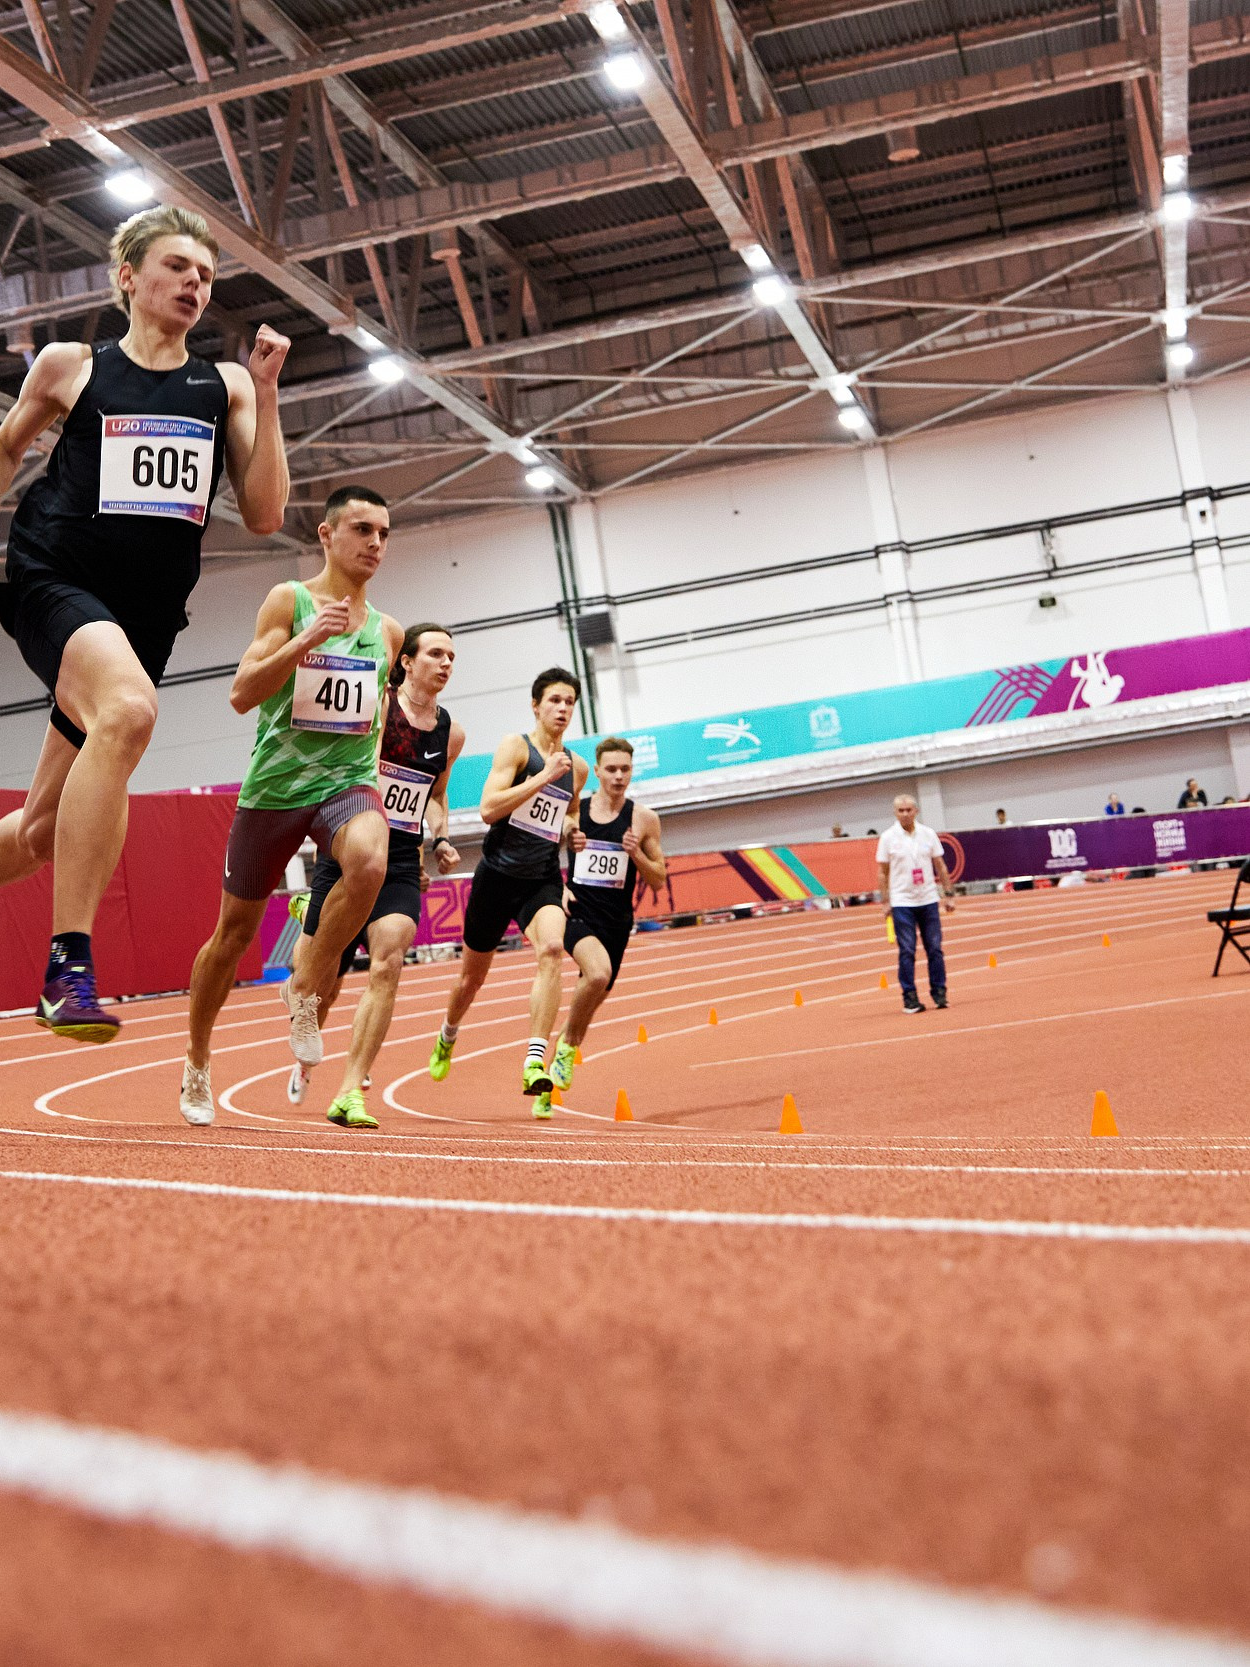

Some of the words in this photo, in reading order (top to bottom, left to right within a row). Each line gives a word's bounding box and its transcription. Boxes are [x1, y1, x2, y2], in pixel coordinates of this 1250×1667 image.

[111, 420, 140, 433] U20
[132, 445, 199, 493] 605
[304, 654, 325, 665] U20
[315, 676, 363, 714] 401
[380, 764, 398, 775] U20
[383, 783, 421, 817] 604
[530, 796, 560, 827] 561
[588, 854, 619, 876] 298
